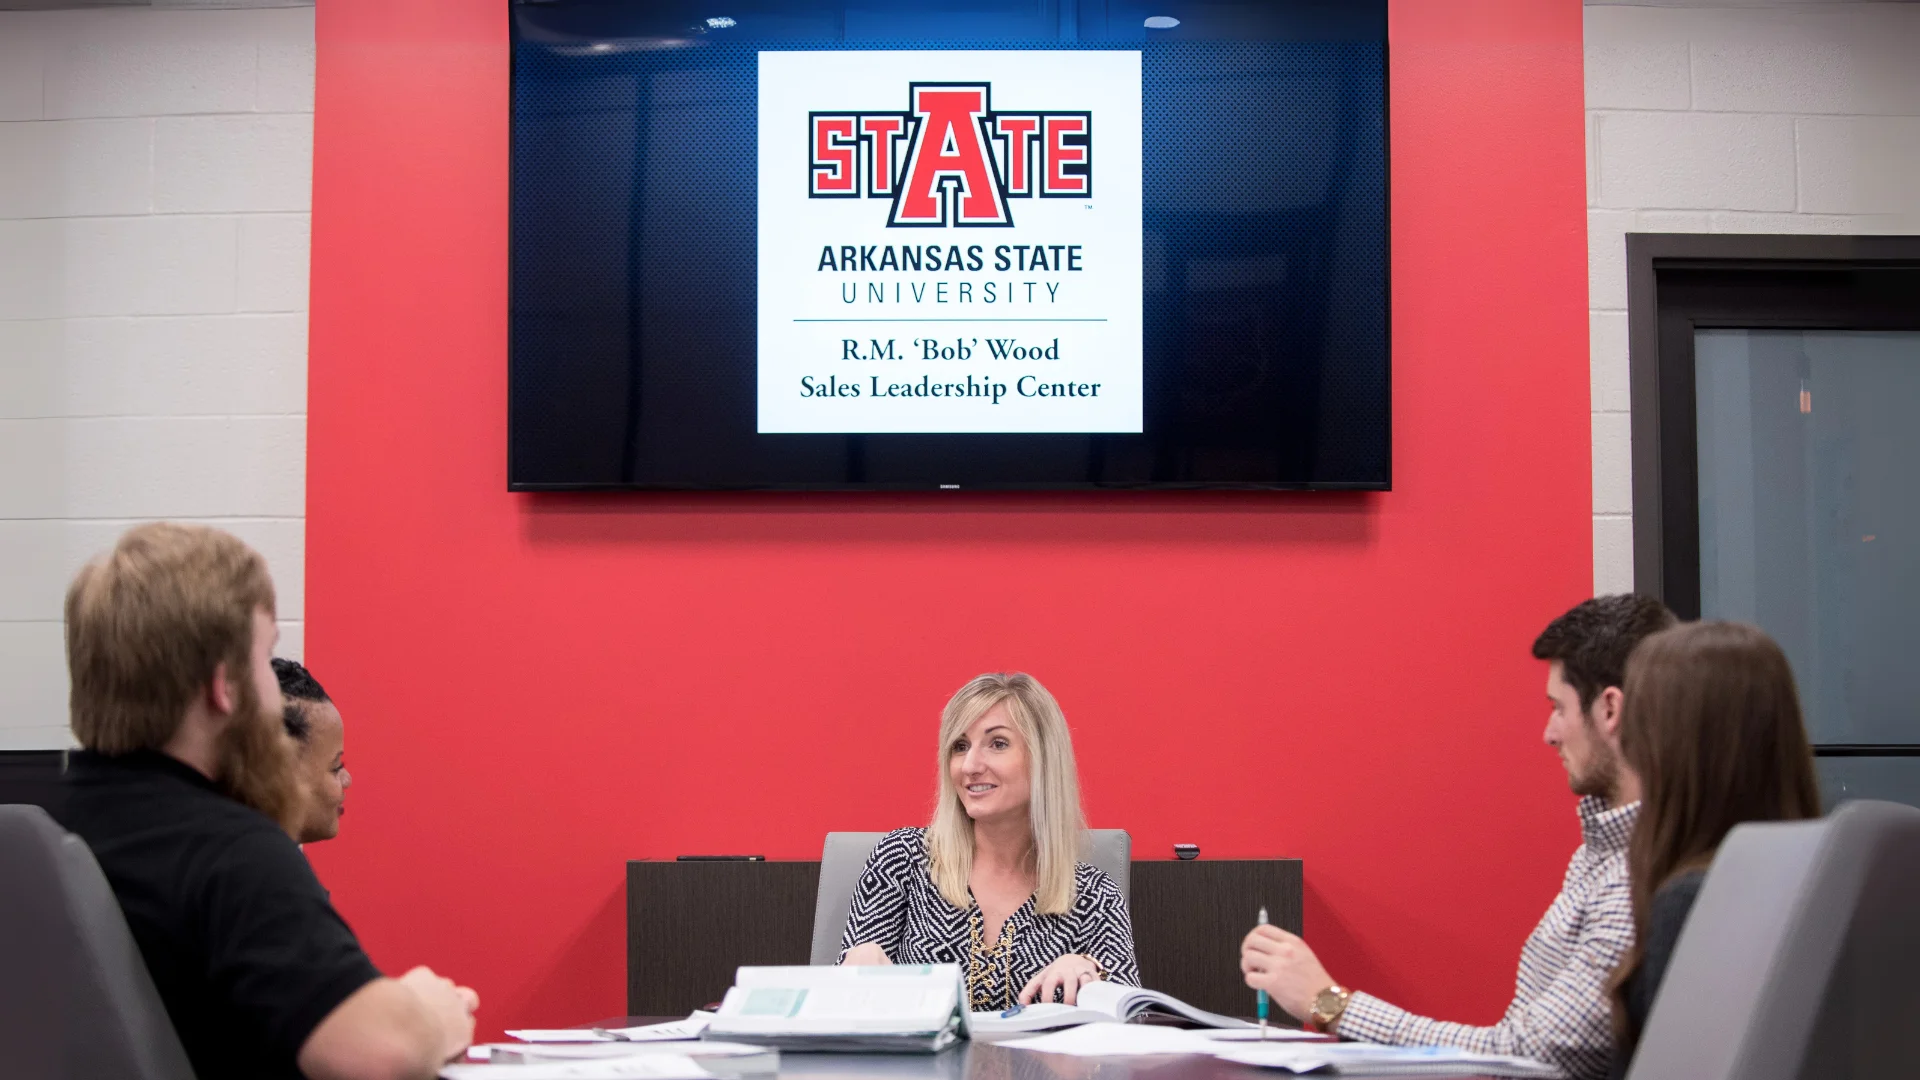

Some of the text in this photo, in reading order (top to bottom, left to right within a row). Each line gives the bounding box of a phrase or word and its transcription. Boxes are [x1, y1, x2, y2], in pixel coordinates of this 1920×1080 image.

[808, 82, 1092, 228] STATE
[818, 245, 1082, 271] ARKANSAS STATE
[843, 282, 1059, 303] UNIVERSITY
[842, 339, 903, 360] R.M.
[985, 338, 1060, 360] Wood
[800, 375, 1101, 404] Sales Leadership Center
